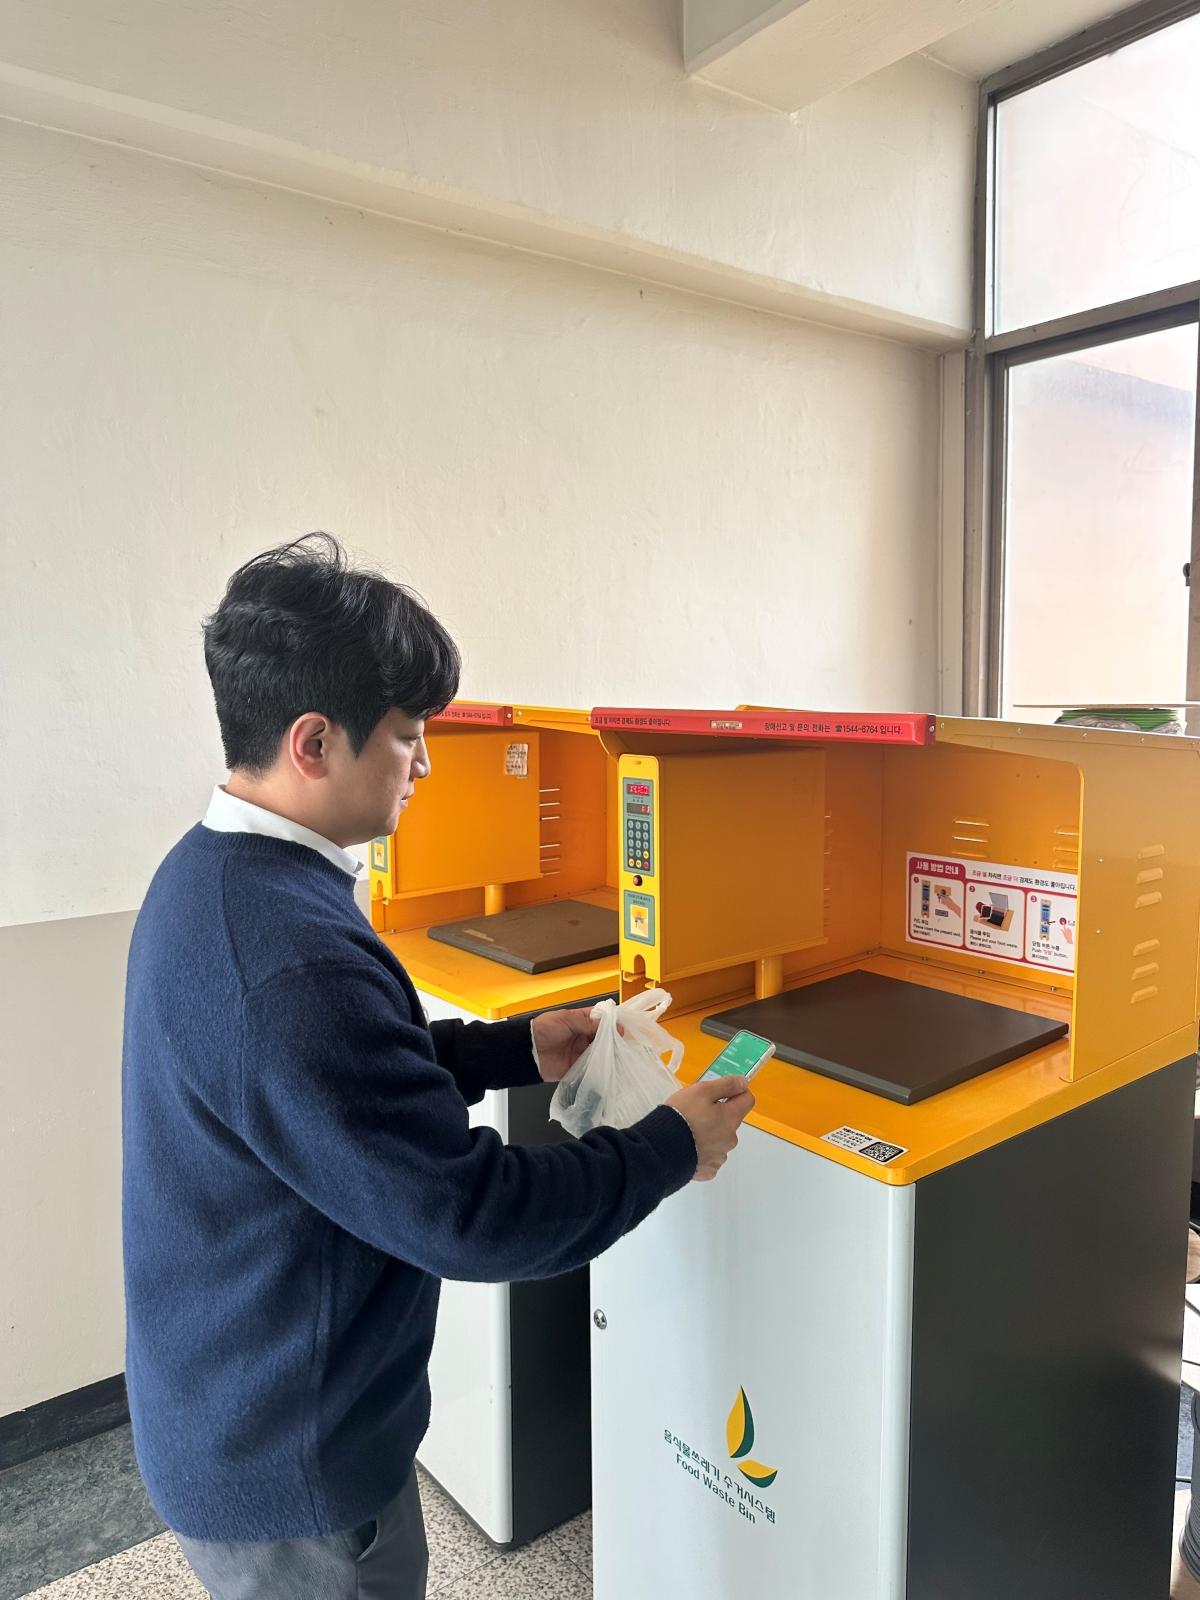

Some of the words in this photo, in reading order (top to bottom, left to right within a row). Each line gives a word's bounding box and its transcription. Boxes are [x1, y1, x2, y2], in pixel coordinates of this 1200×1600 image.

[916, 861, 928, 870] 사용
[930, 863, 944, 873] 방법
[945, 865, 958, 874] 안내
[664, 1429, 720, 1481] 음식물쓰레기
[723, 1475, 776, 1524] 수거시스템
[676, 1453, 700, 1480] Food
[702, 1474, 736, 1508] Waste
[738, 1502, 756, 1524] Bin
